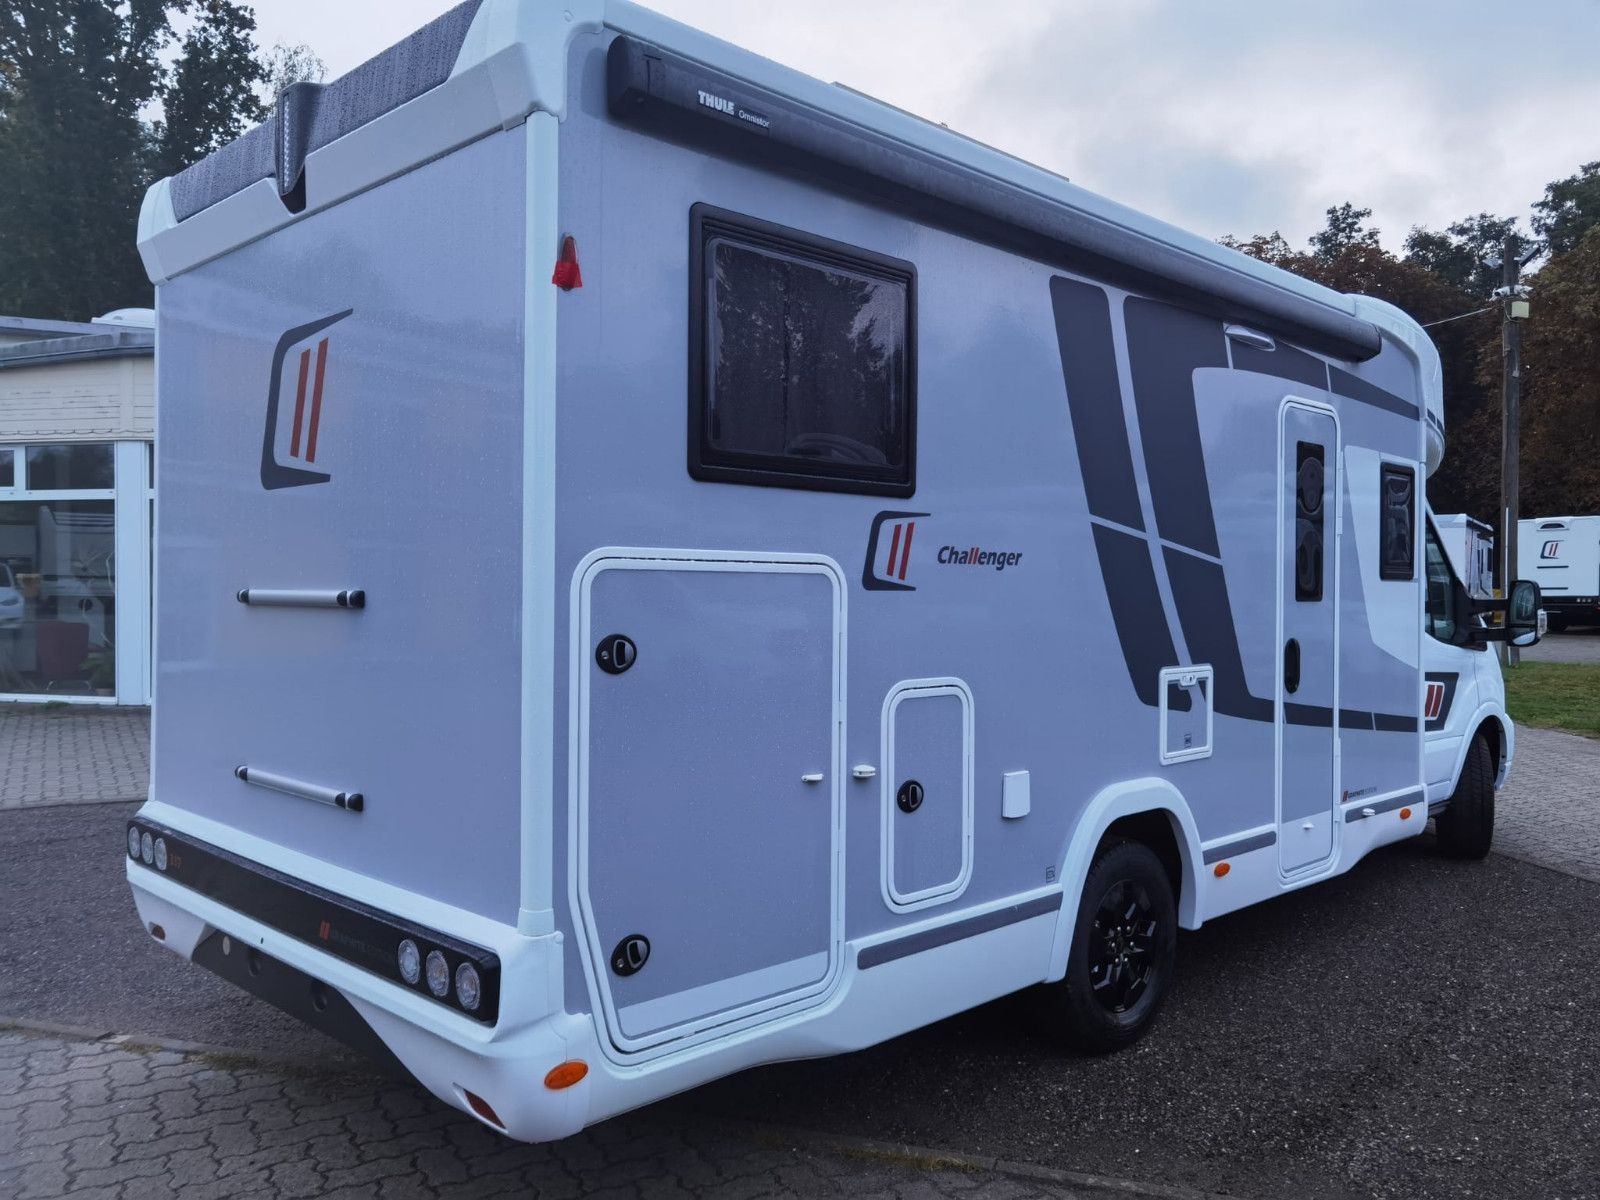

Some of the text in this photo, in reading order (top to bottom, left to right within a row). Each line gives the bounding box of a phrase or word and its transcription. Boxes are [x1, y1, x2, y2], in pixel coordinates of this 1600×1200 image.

[698, 90, 769, 127] THULE Omnistor
[937, 545, 1023, 571] Challenger
